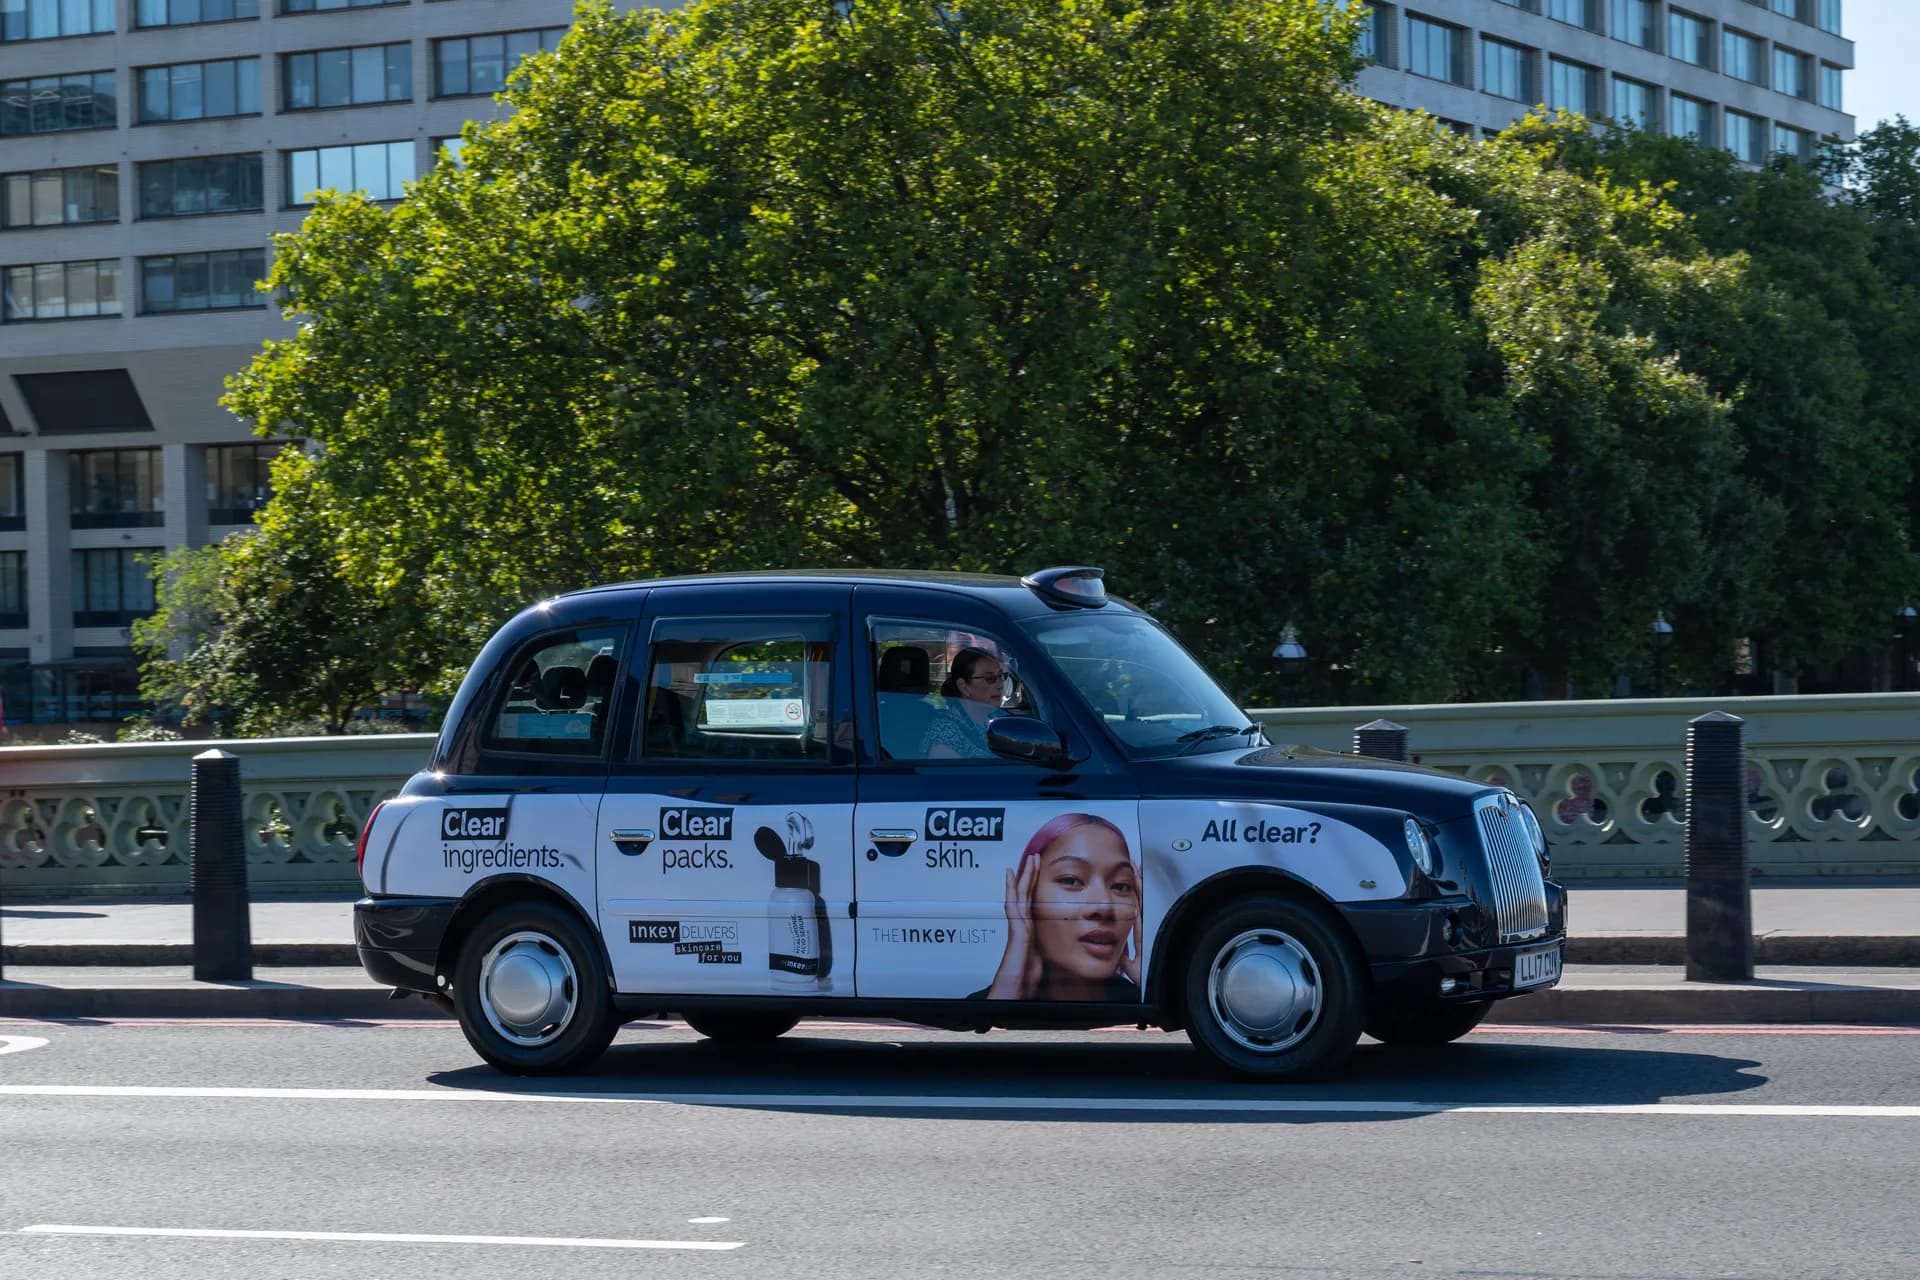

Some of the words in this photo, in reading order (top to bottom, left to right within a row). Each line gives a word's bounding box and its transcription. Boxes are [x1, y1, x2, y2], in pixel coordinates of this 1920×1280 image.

[444, 810, 504, 837] Clear
[662, 808, 730, 837] Clear
[928, 809, 1002, 837] Clear
[1201, 818, 1238, 842] All
[1243, 819, 1322, 844] clear?
[443, 842, 564, 874] ingredients.
[662, 842, 734, 874] packs.
[926, 841, 980, 868] skin.
[681, 925, 736, 940] DELIVERS
[872, 927, 899, 943] THE
[676, 943, 721, 953] skincare
[702, 952, 719, 963] for
[721, 955, 740, 964] you
[1520, 954, 1543, 982] LL17
